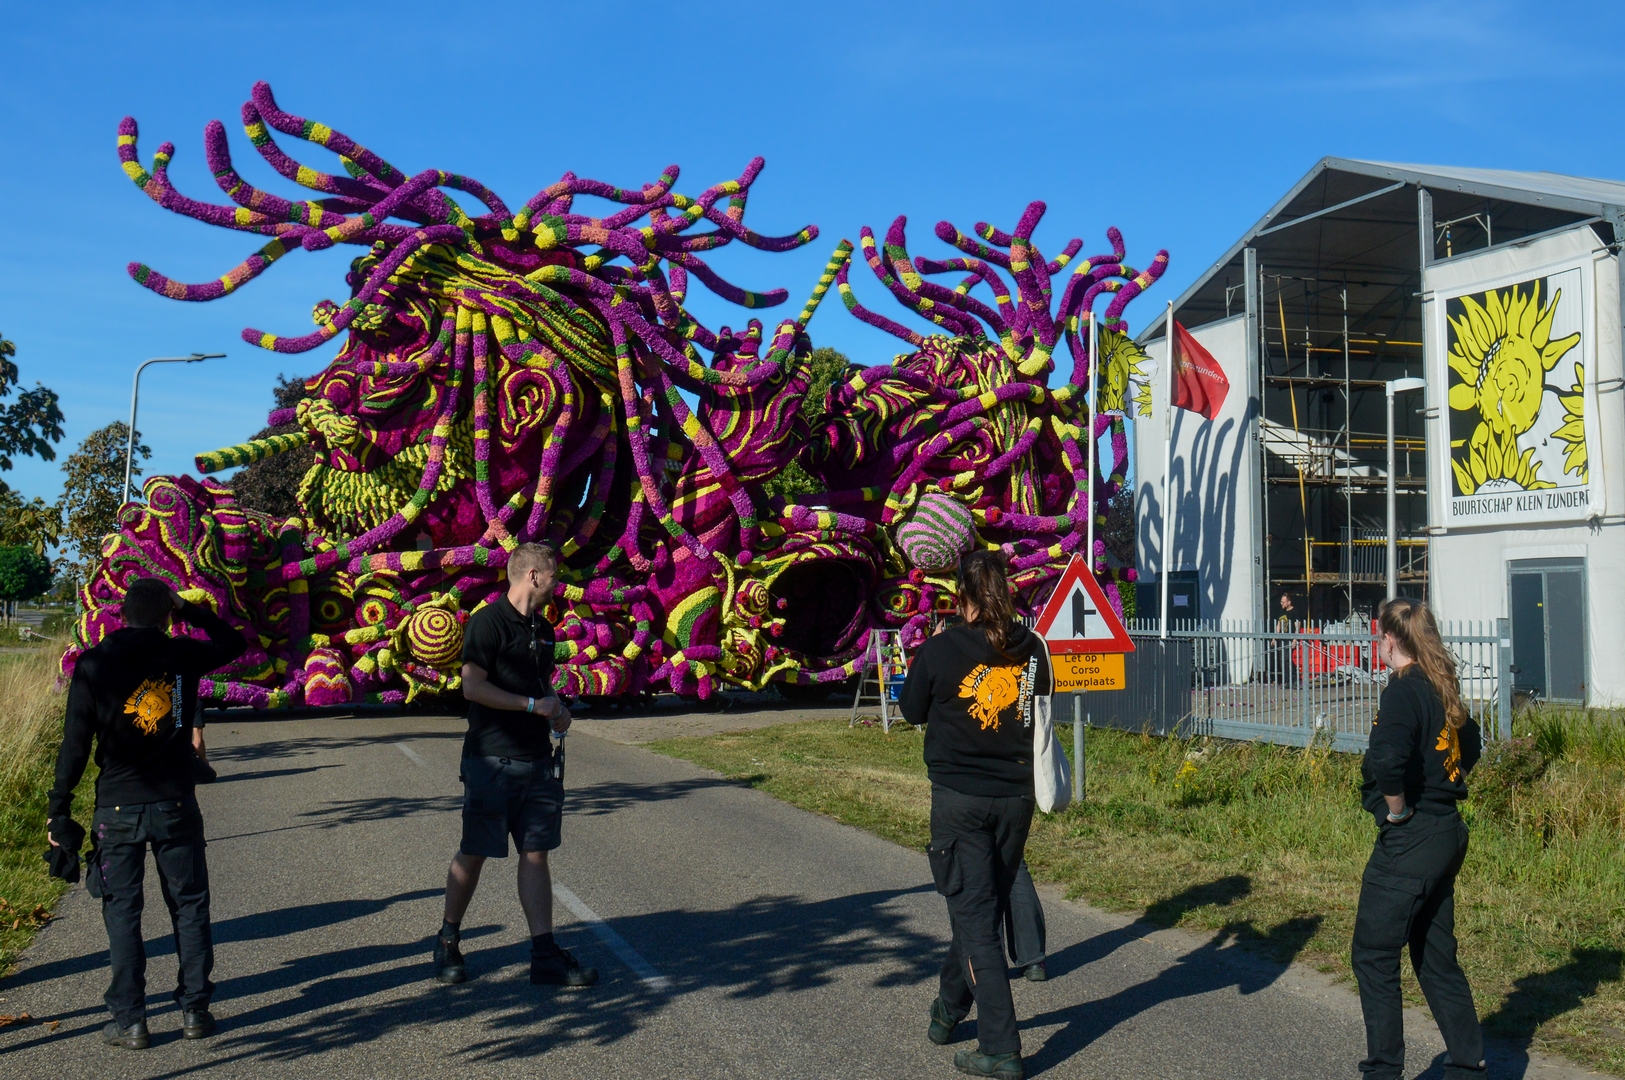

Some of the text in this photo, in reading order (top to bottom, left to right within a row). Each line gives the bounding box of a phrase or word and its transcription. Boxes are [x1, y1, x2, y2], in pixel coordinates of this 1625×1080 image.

[1452, 489, 1590, 516] BUURTSCHAP KLEIN ZUNDERT
[1064, 653, 1082, 663] Let
[1085, 655, 1097, 663] op
[1071, 666, 1100, 675] Corso
[1056, 677, 1116, 688] bouwplaats
